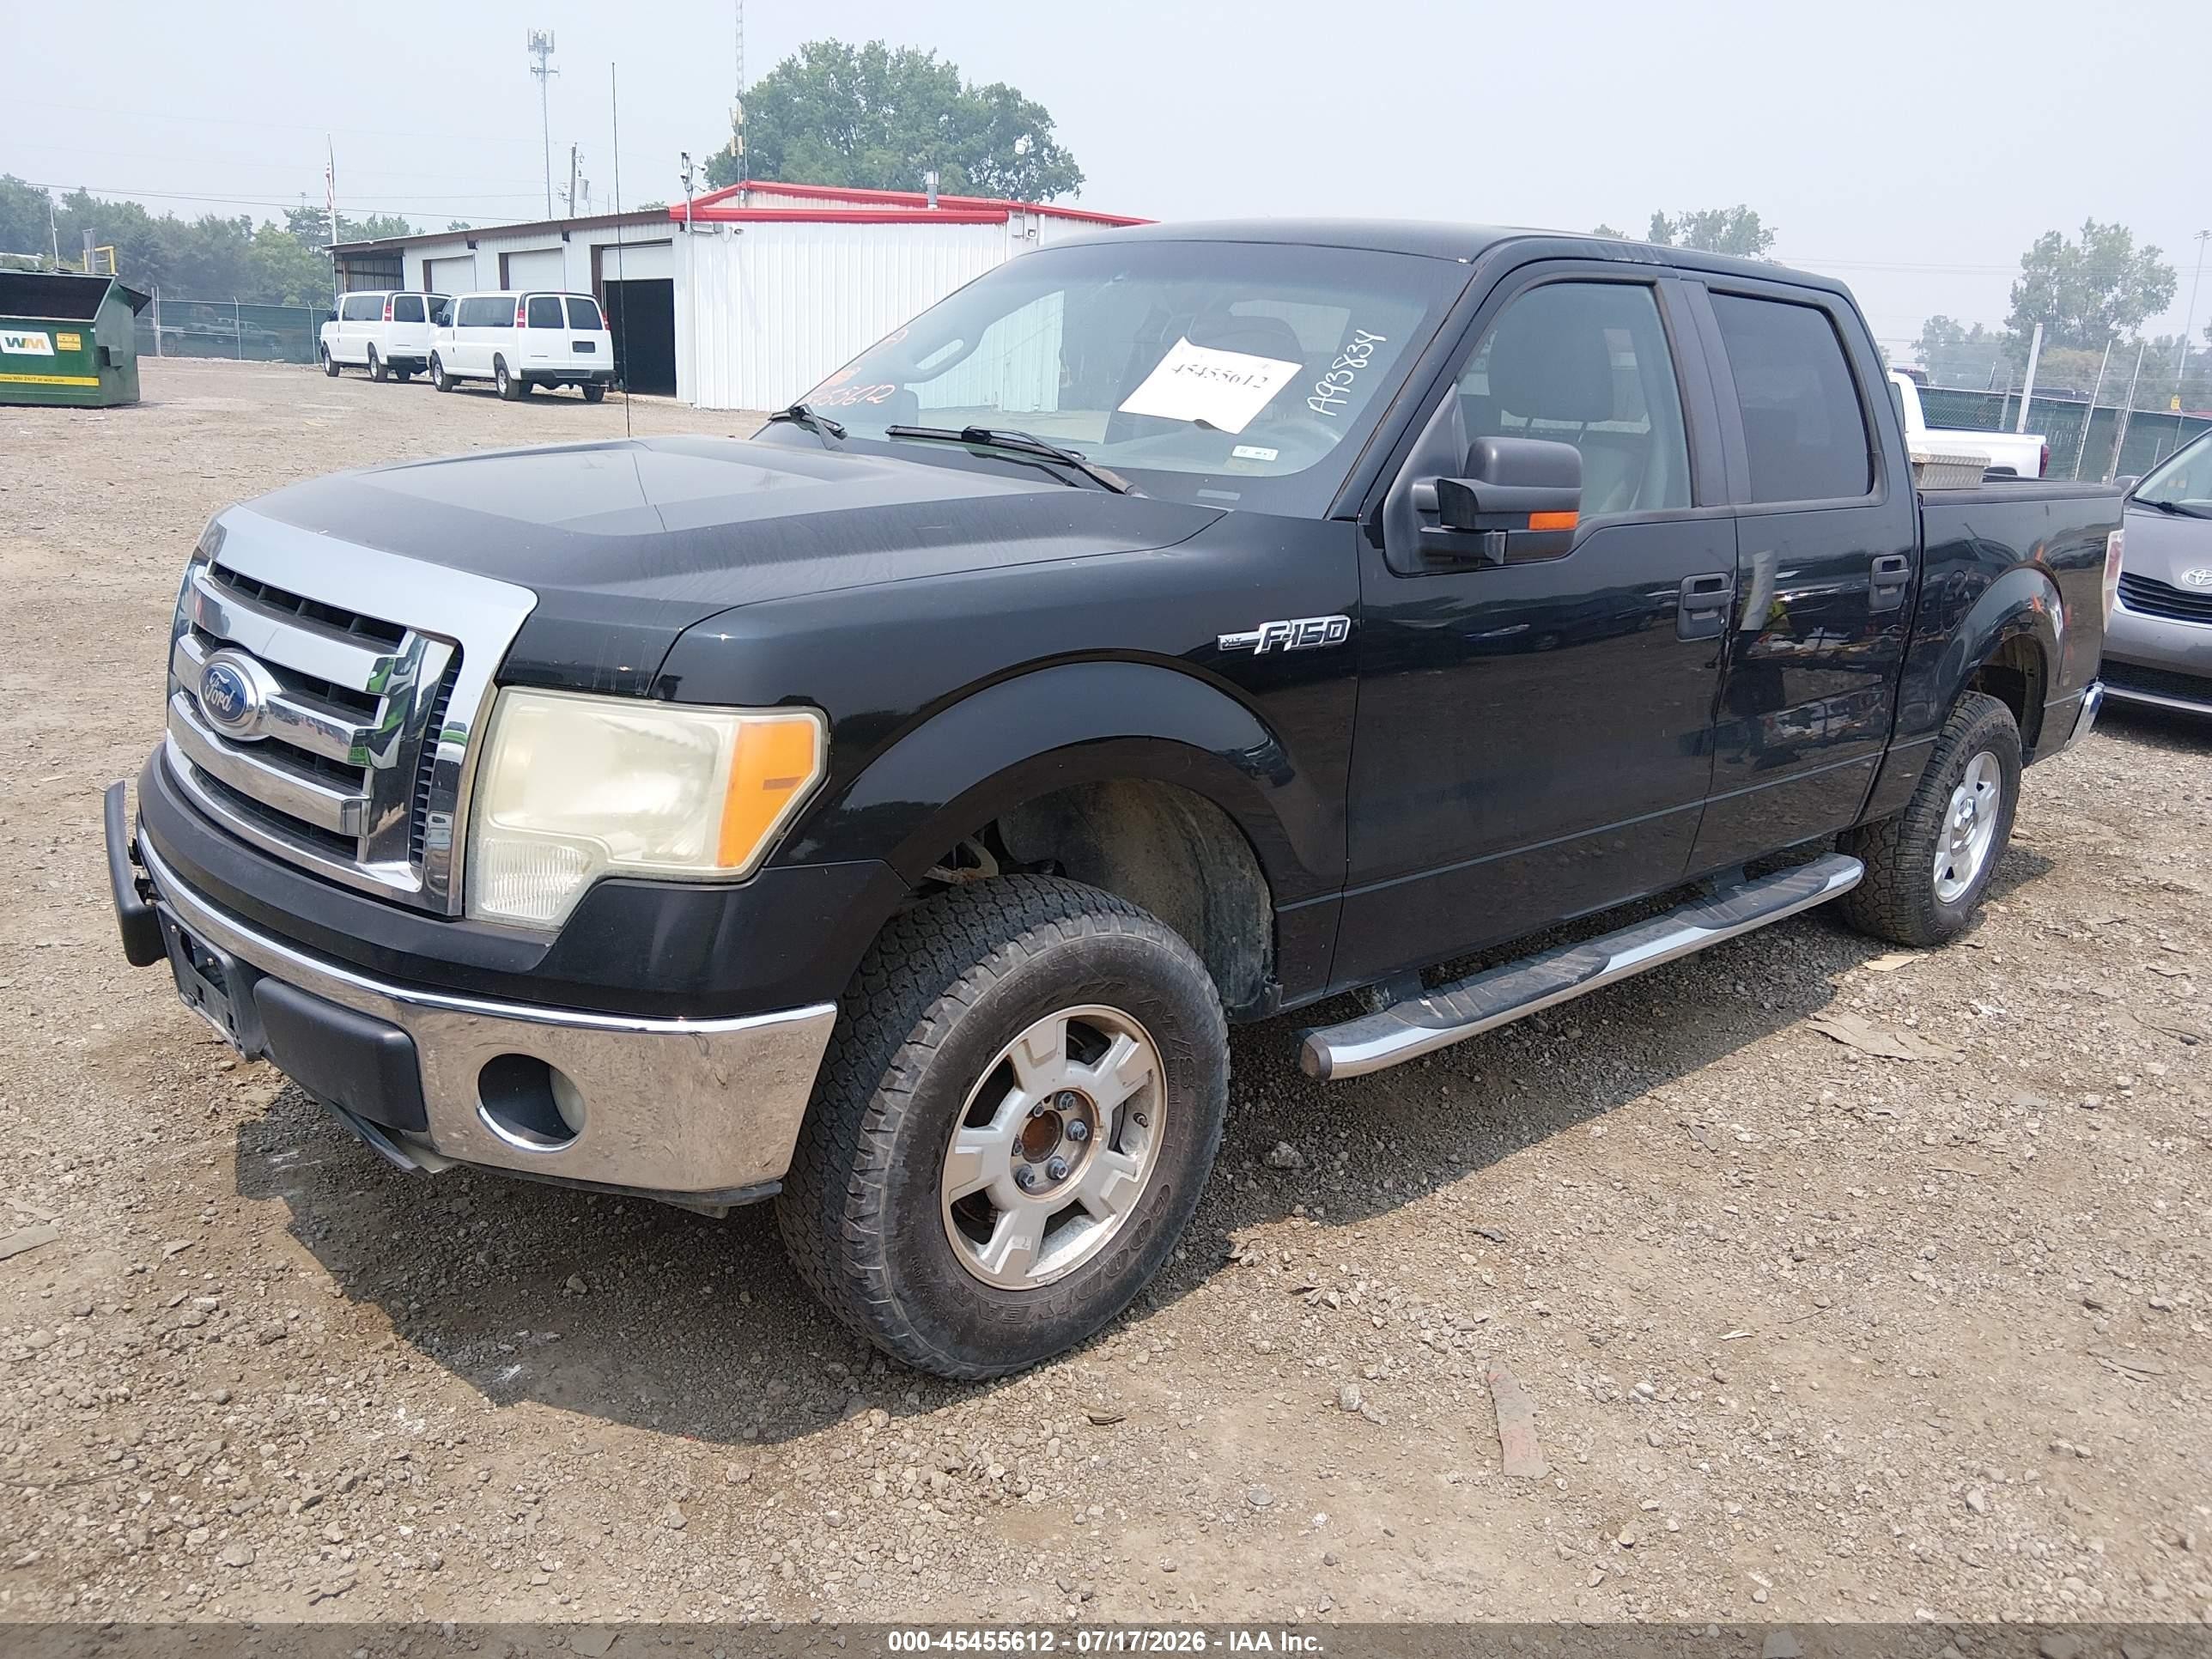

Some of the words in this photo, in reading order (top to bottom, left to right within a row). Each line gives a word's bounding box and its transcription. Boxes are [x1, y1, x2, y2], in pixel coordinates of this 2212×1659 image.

[5, 337, 46, 349] WM
[1223, 637, 1242, 647] XLT
[205, 671, 234, 712] Ford
[951, 1184, 1170, 1325] GOODYEAR
